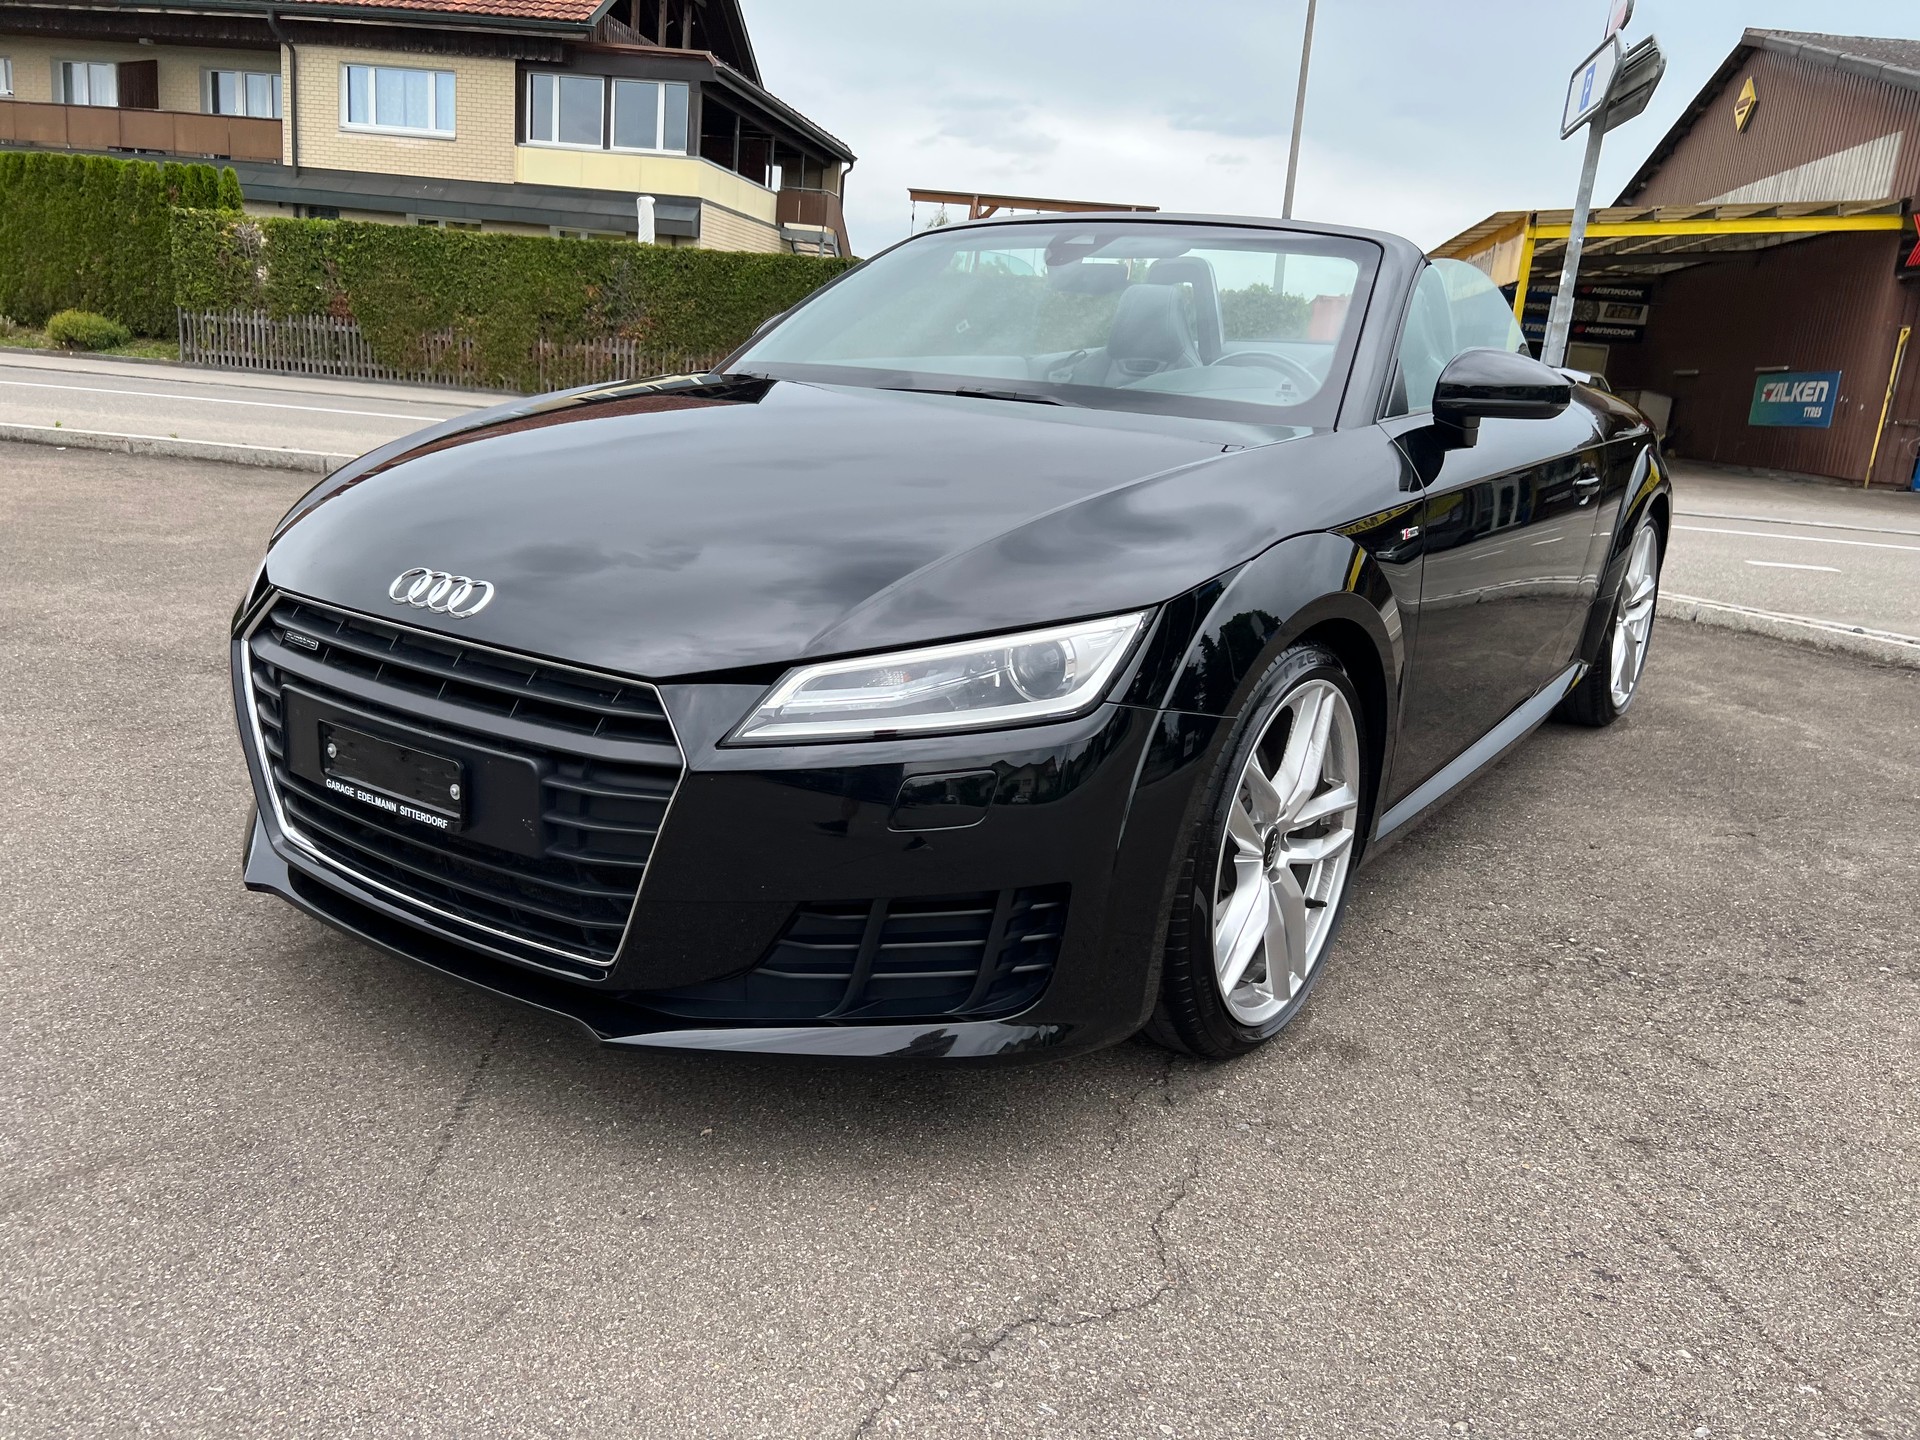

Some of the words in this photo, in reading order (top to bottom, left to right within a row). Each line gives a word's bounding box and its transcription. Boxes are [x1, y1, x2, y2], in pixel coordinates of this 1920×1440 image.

[1760, 380, 1830, 403] FALKEN
[1803, 406, 1823, 418] TYRES
[326, 778, 355, 797] GARAGE
[357, 790, 397, 813] EDELMANN
[399, 805, 448, 829] SITTERDORF
